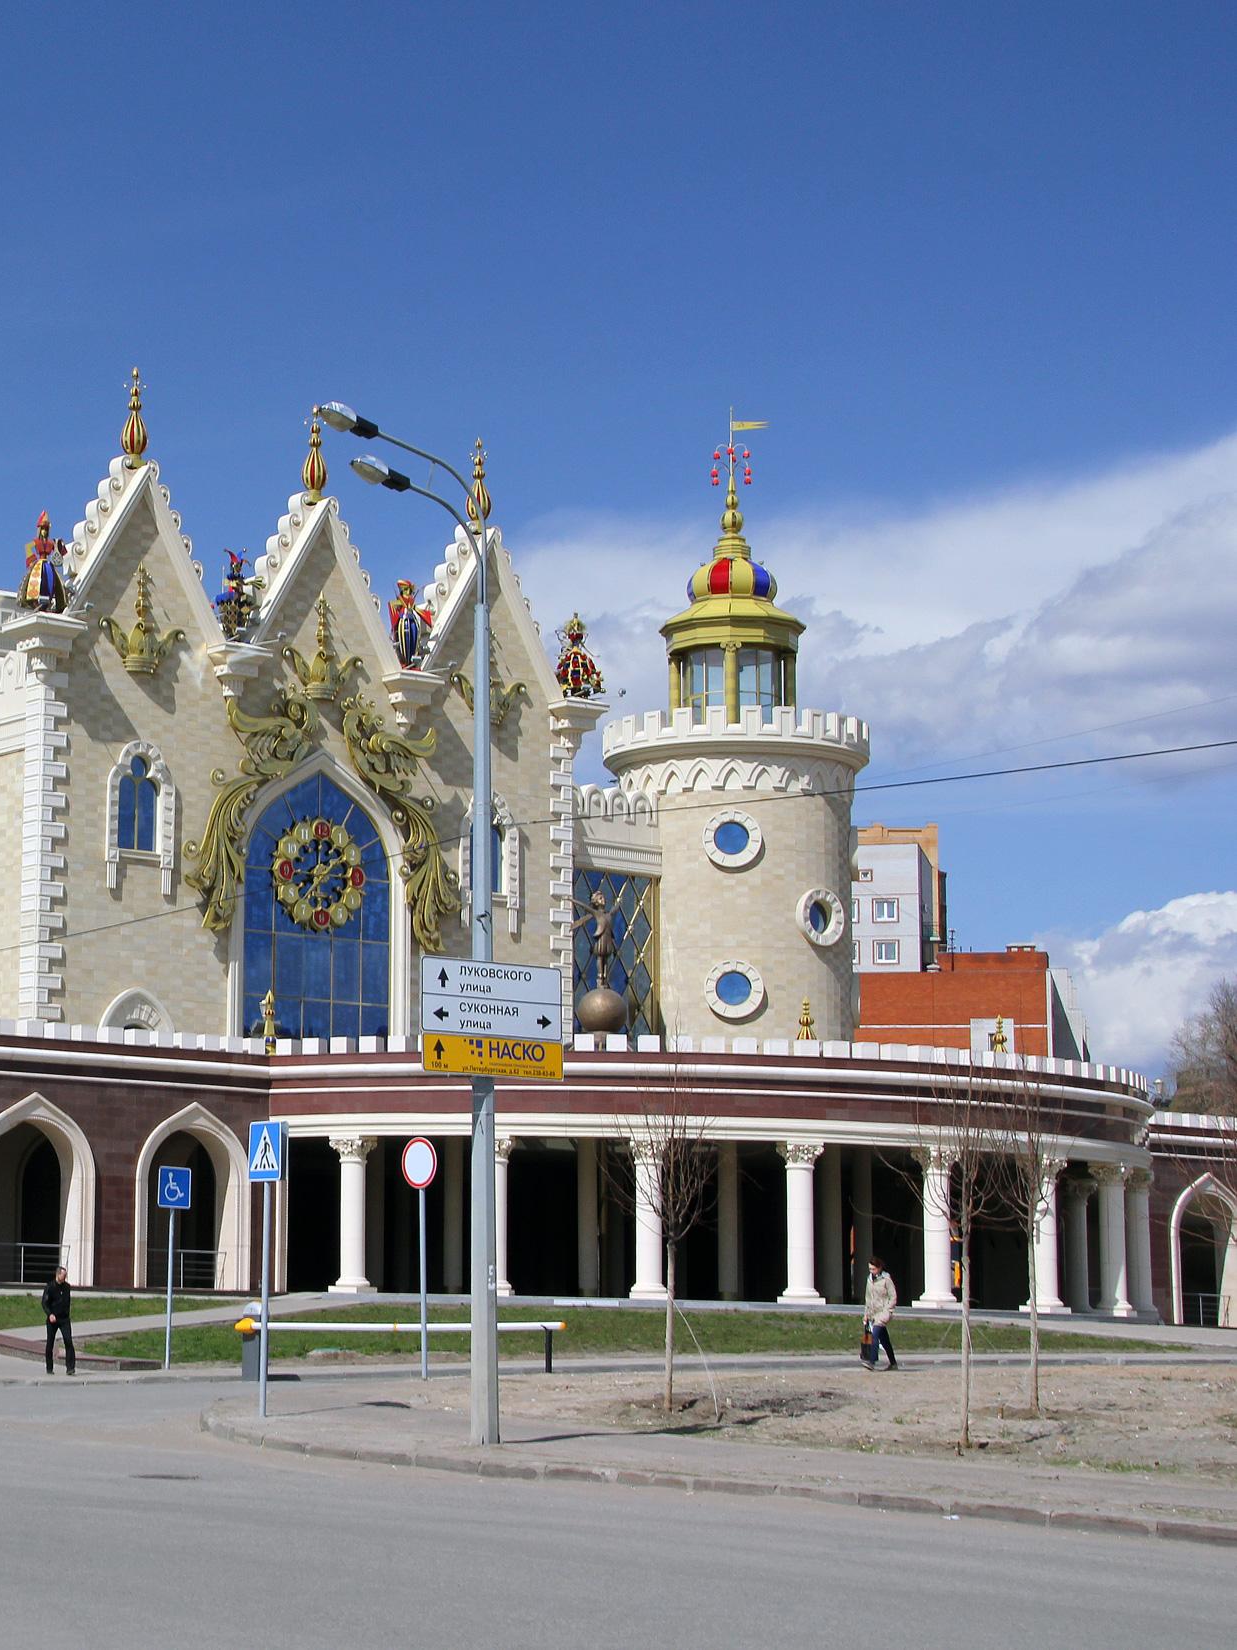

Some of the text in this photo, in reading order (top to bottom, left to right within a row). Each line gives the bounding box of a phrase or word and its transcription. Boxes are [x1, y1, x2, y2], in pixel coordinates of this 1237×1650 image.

[459, 965, 532, 982] ЛУКОВСКОГО
[459, 983, 492, 995] улица
[459, 1002, 519, 1017] СУКОННАЯ
[459, 1019, 492, 1031] улица
[488, 1040, 546, 1063] НАСКО
[431, 1061, 442, 1069] 100
